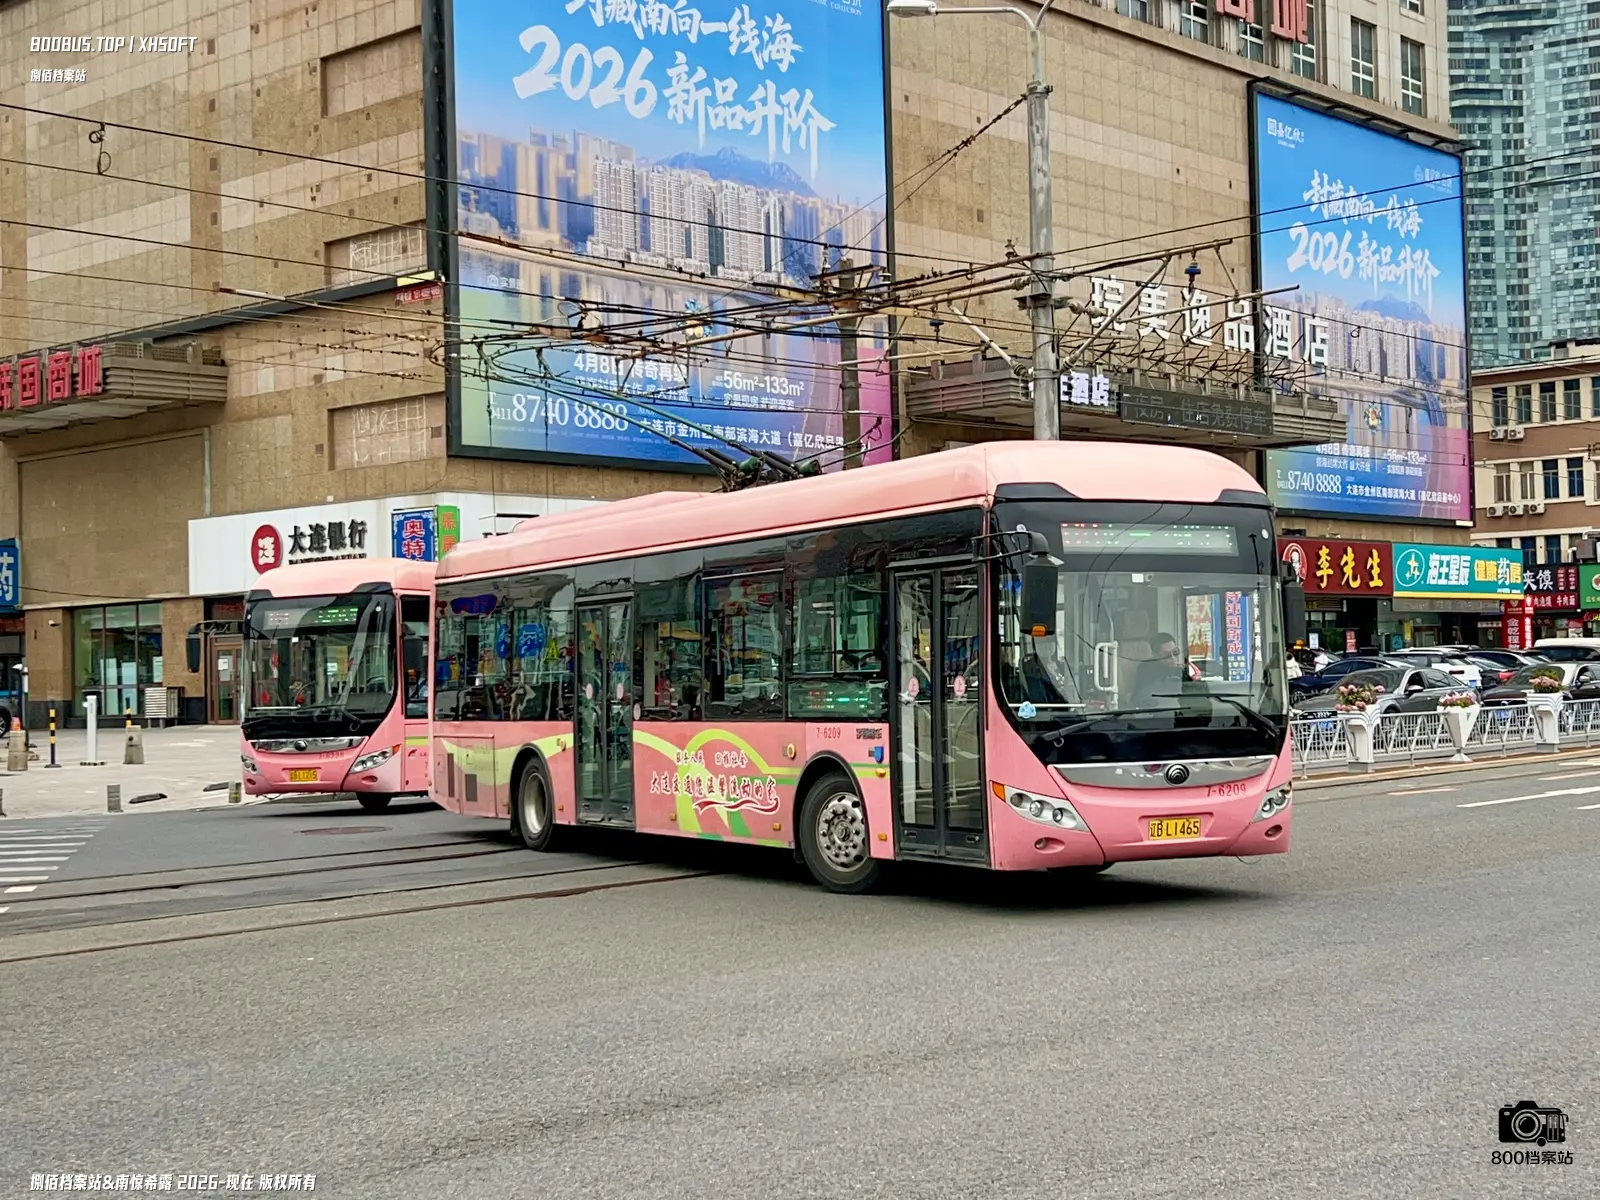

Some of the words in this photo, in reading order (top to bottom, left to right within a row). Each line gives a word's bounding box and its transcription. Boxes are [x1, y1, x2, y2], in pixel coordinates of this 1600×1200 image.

[513, 25, 657, 119] 2026
[662, 51, 838, 172] 新品升阶
[1303, 169, 1423, 238] 封藏南向一线海
[1287, 222, 1354, 279] 2026
[1357, 230, 1441, 300] 新品升阶
[512, 393, 570, 426] 8740
[574, 398, 629, 431] 8888
[1288, 470, 1314, 491] 8740
[1316, 473, 1342, 494] 8888
[288, 519, 368, 555] 大连银行
[402, 519, 426, 561] 奥特
[1315, 545, 1384, 589] 李先生
[1427, 553, 1471, 585] 海王星辰
[1474, 557, 1522, 586] 健康药房
[816, 727, 841, 739] 7-6209
[1206, 783, 1247, 797] 7-6209
